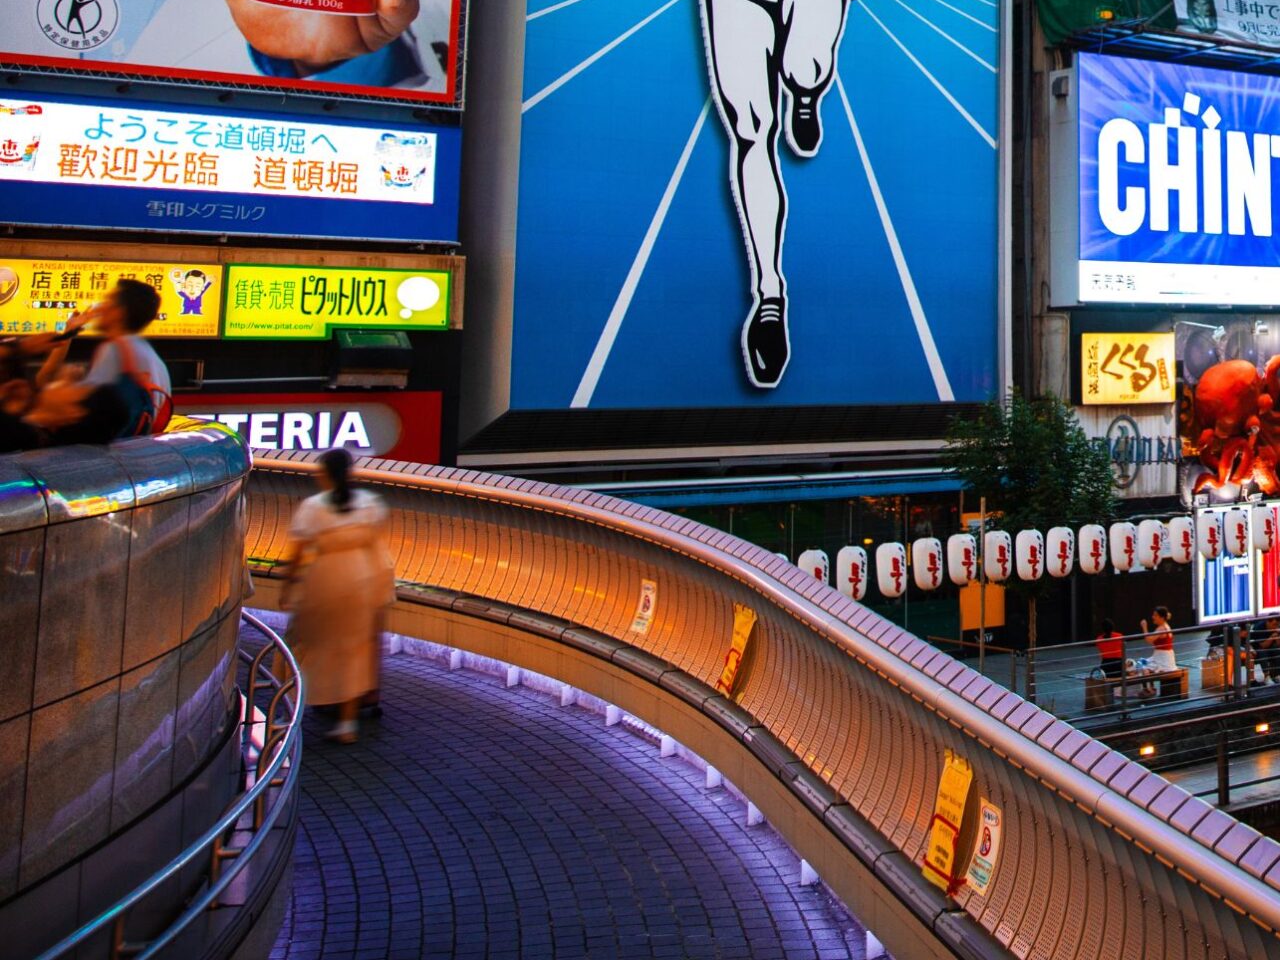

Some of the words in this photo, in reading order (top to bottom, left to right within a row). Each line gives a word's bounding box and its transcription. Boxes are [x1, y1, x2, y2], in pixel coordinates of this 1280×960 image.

[84, 113, 338, 154] ようこそ道頓堀へ
[253, 155, 359, 194] 道頓堀
[146, 200, 266, 221] 雪印メグミルク
[235, 279, 296, 310] 賃貸・売買
[300, 276, 388, 316] ピタットハウス
[230, 322, 314, 330] http://www.pitat.com/
[188, 411, 371, 450] TERIA
